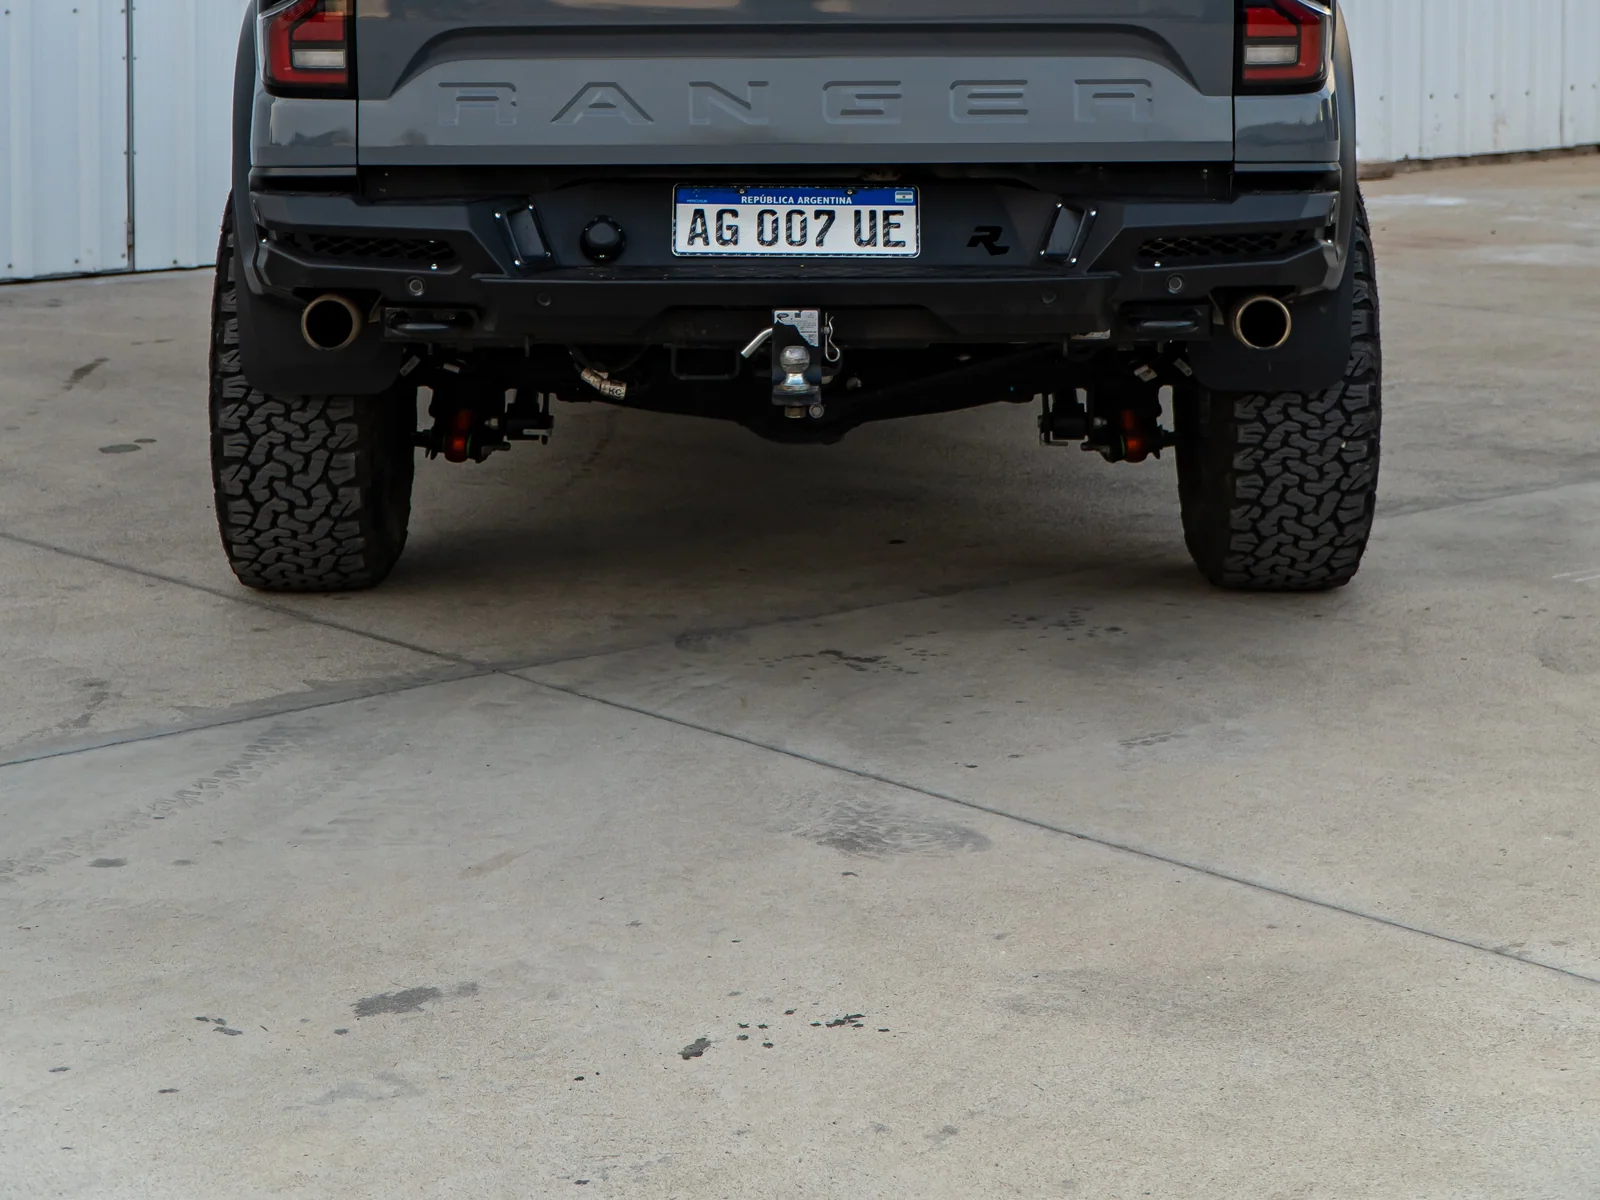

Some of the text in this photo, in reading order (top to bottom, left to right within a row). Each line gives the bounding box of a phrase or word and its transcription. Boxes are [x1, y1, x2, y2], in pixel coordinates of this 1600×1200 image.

[438, 80, 1153, 125] RANGER
[741, 194, 853, 205] REPÚBLICA ARGENTINA
[686, 208, 907, 248] AG 007 UE
